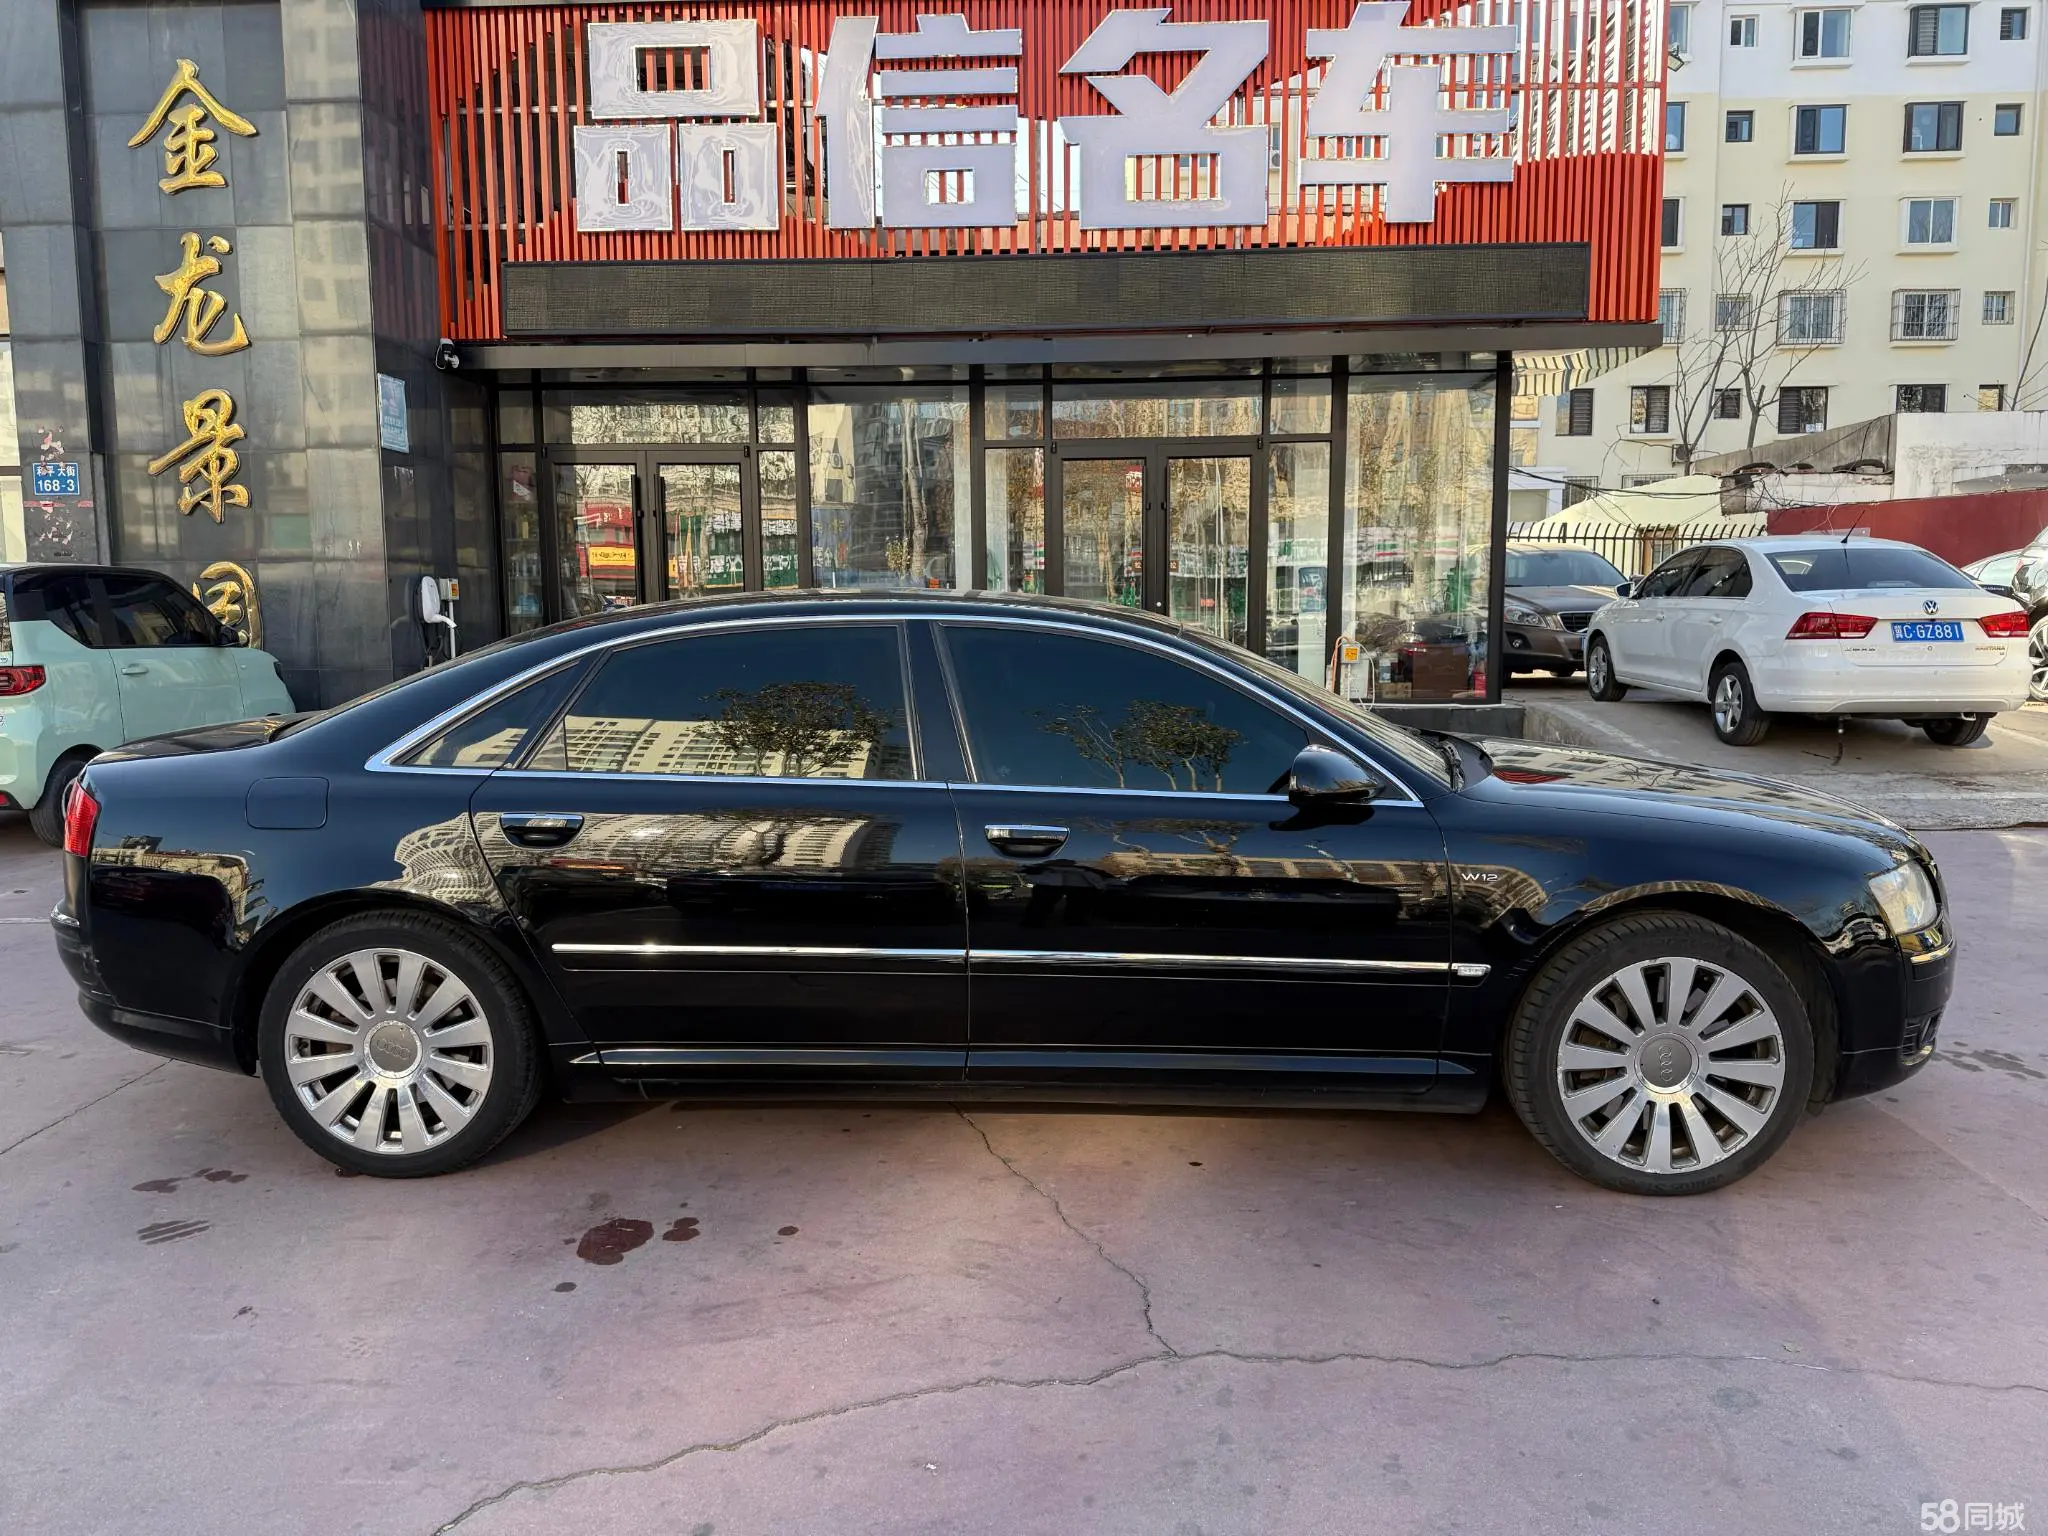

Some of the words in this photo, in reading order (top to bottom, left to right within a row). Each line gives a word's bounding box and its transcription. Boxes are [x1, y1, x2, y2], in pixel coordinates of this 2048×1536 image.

[573, 0, 1517, 233] 品信名车
[37, 479, 75, 492] 168-3
[1461, 872, 1498, 882] W12
